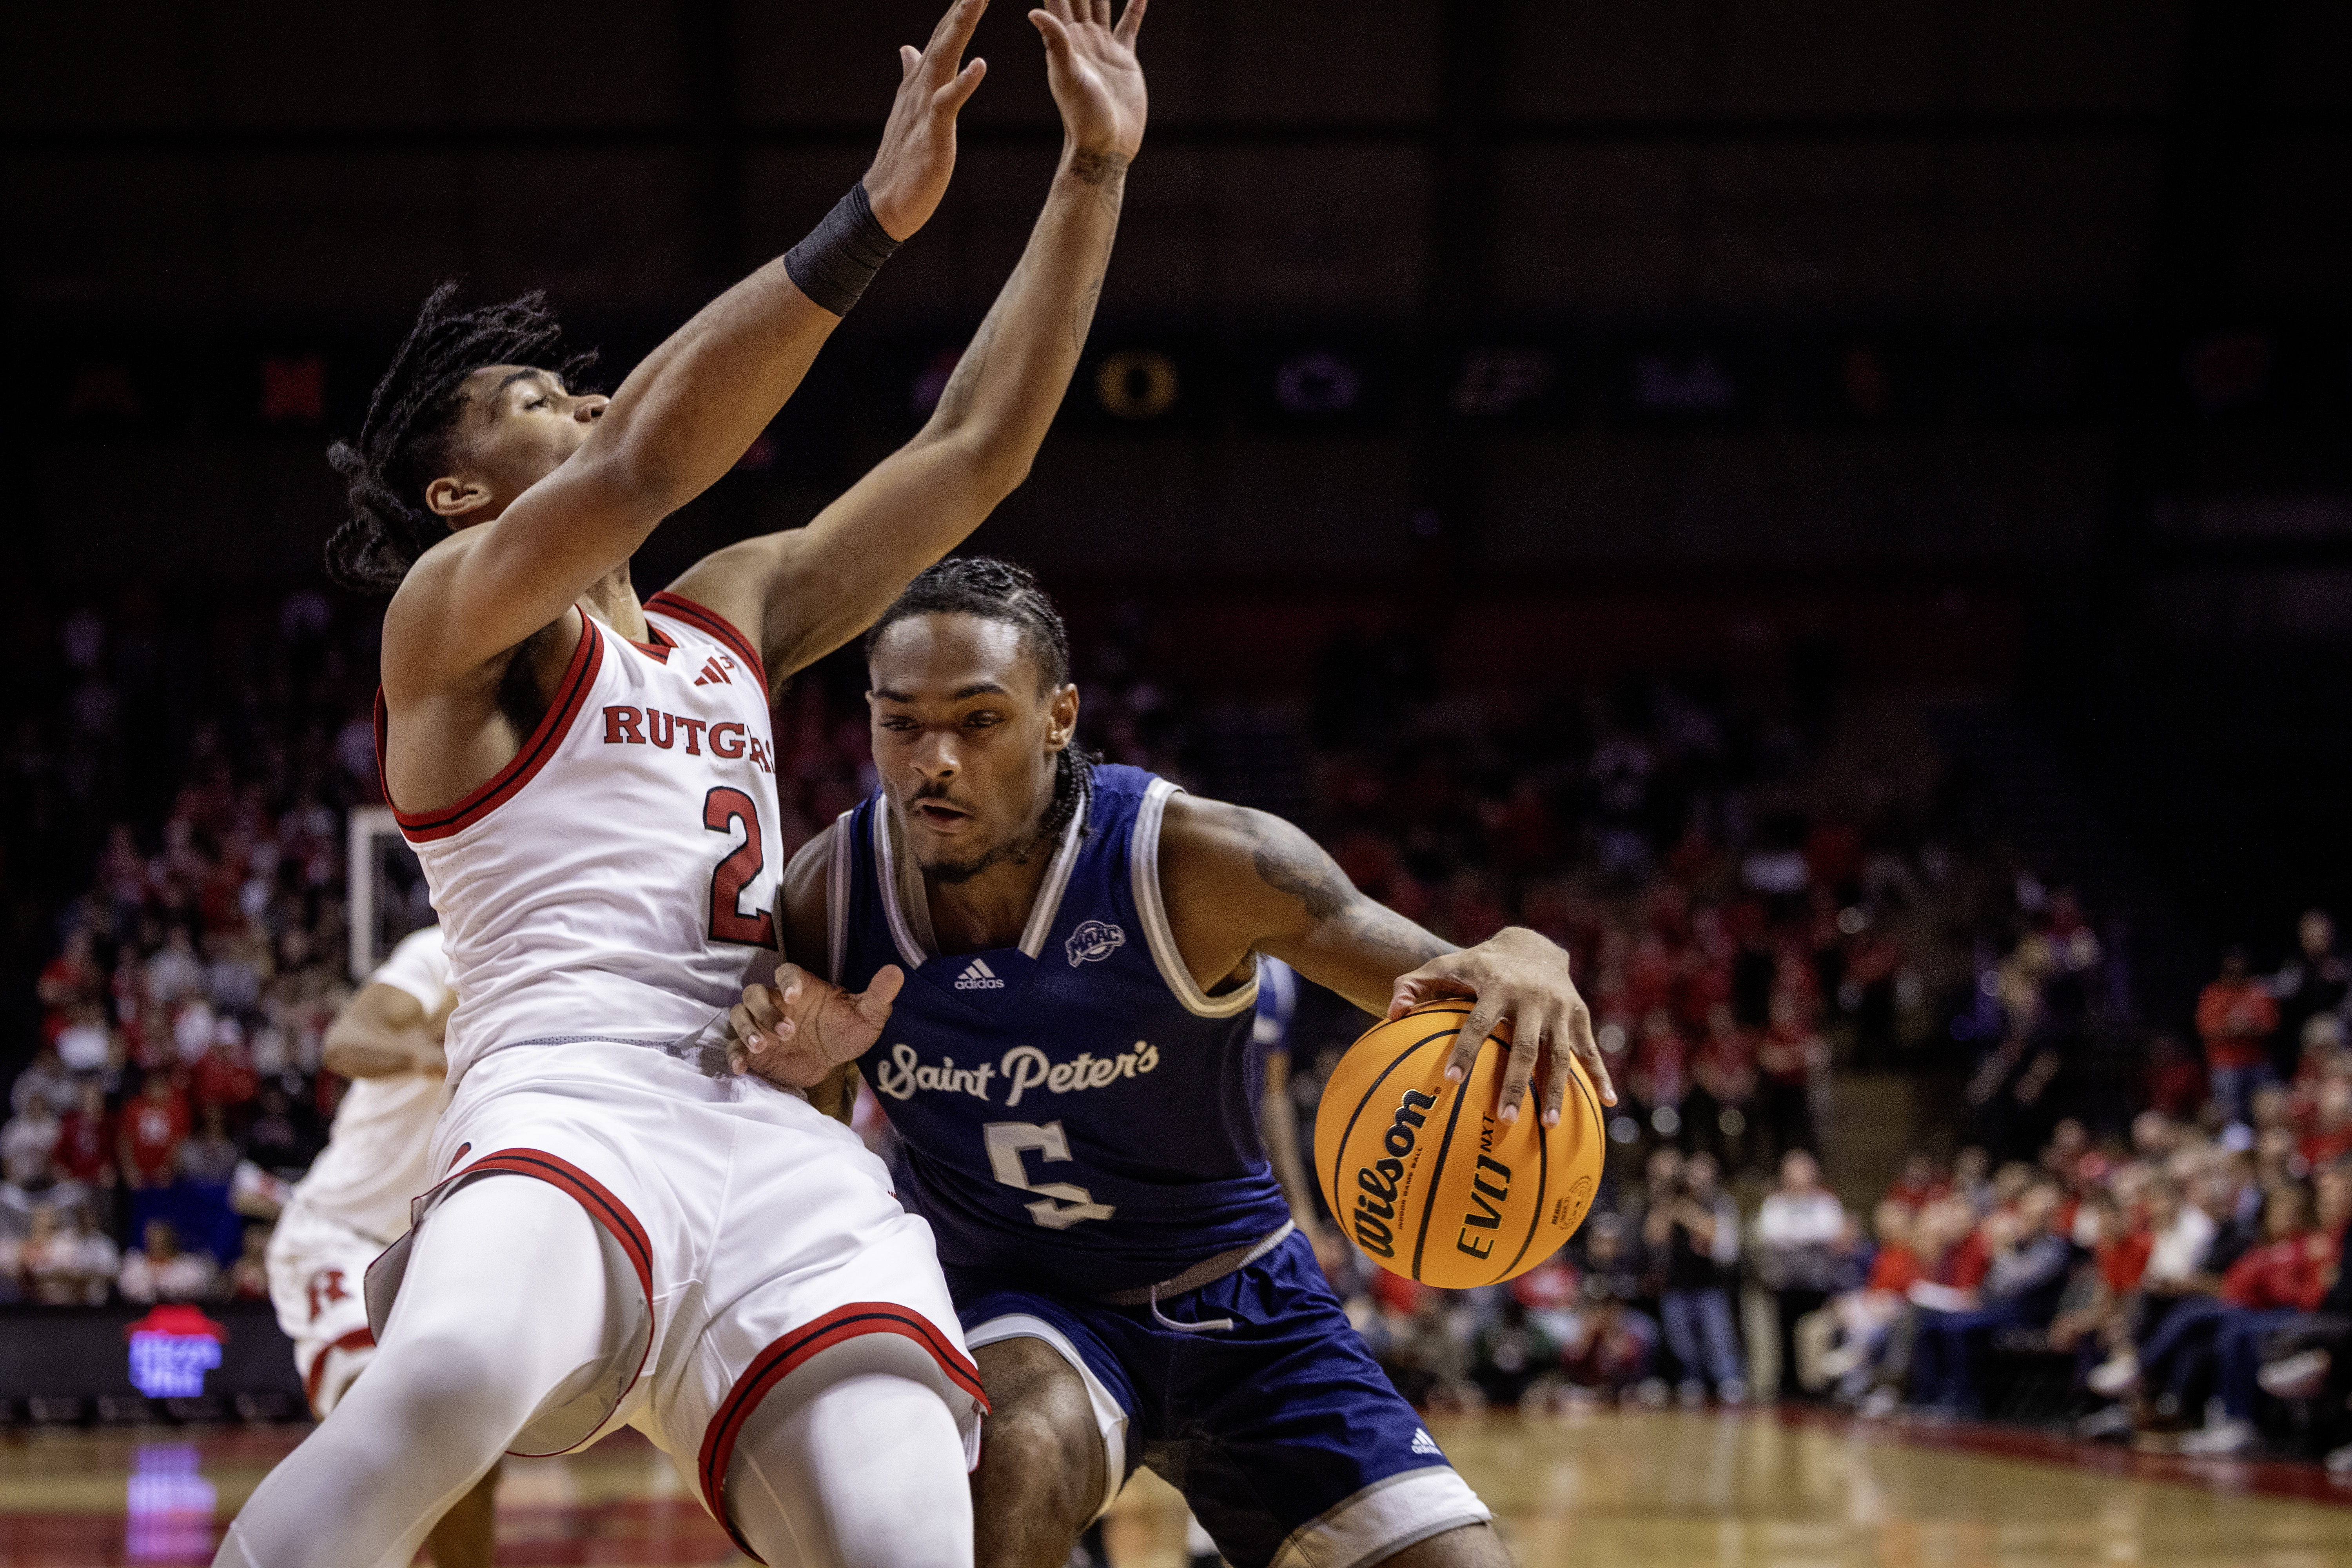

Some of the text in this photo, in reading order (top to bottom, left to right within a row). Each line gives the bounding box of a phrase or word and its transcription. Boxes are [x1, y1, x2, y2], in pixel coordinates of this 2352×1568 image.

[603, 706, 775, 773] RUTGR
[703, 786, 779, 951] 2
[954, 978, 1005, 989] adidas
[877, 1040, 1159, 1106] Saint Peter's
[1480, 1111, 1494, 1153] NXT
[983, 1120, 1116, 1230] 5
[1354, 1089, 1437, 1258] Wilson
[1398, 1200, 1406, 1230] INDOOR
[1411, 1147, 1423, 1169] BALL
